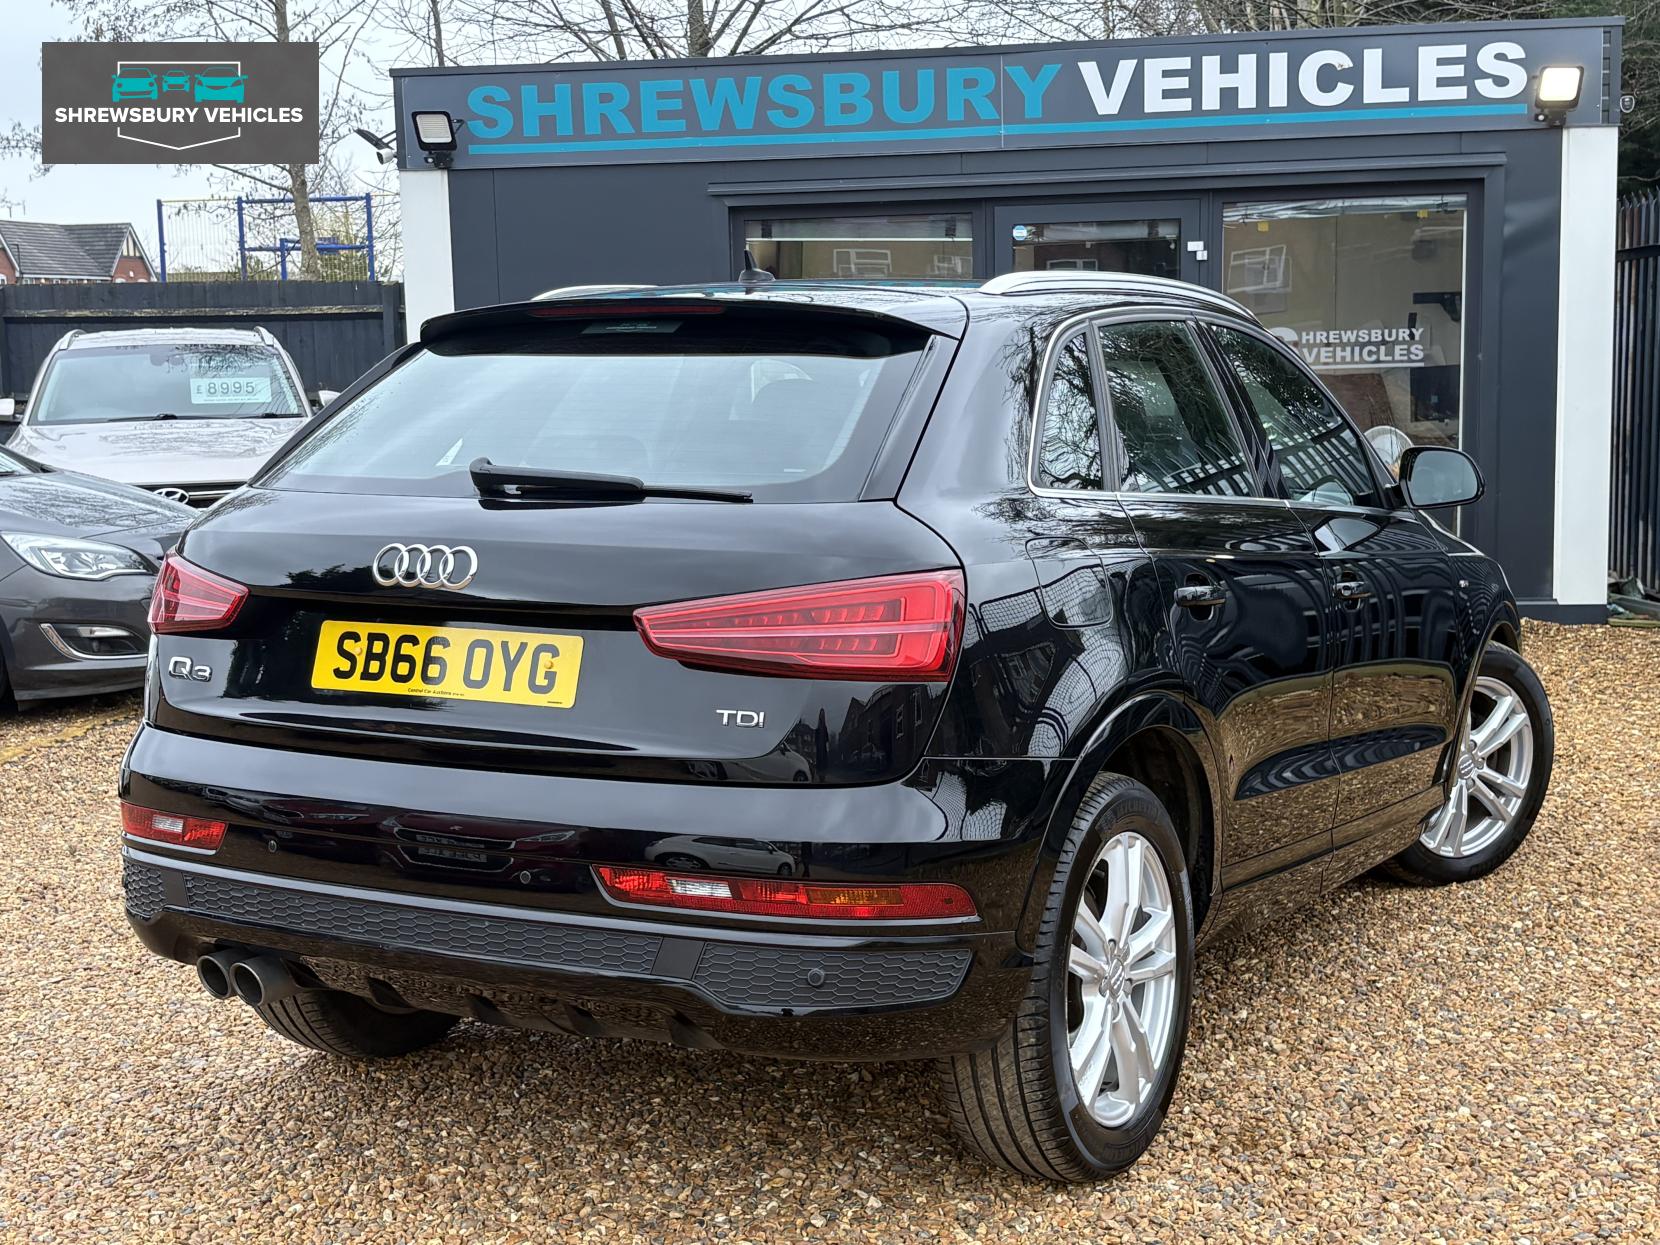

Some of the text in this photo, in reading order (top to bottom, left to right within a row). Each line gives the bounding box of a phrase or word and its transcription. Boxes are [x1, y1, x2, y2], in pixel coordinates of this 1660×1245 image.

[467, 42, 1528, 139] SHREWSBURY VEHICLES
[1302, 344, 1425, 363] VEHICLES
[207, 381, 255, 395] 8995
[169, 656, 212, 682] Q3
[333, 631, 560, 695] SB66 OYG
[716, 709, 765, 728] TDI
